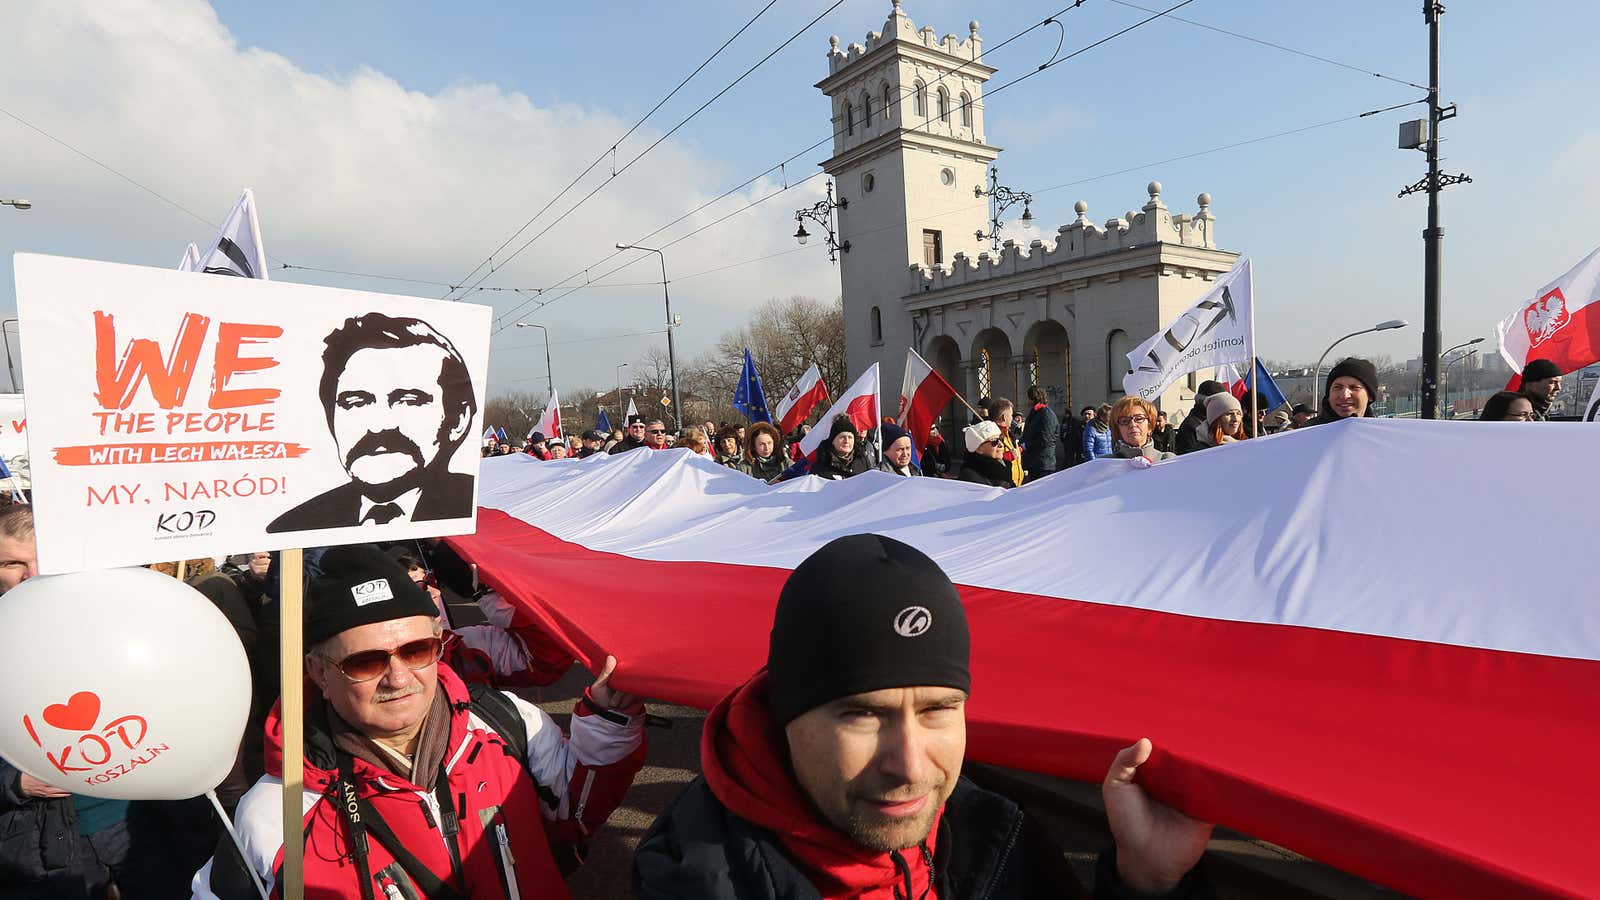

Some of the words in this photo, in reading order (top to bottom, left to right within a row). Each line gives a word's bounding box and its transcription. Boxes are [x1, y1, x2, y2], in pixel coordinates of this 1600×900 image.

[93, 310, 284, 410] WE
[92, 412, 155, 436] THE
[167, 412, 275, 435] PEOPLE
[89, 447, 142, 465] WITH
[150, 446, 204, 463] LECH
[86, 483, 150, 507] MY,
[164, 473, 287, 502] NARÓD!
[156, 509, 216, 533] KOD
[355, 580, 388, 596] KOD
[23, 713, 42, 748] I
[343, 781, 361, 823] SONY
